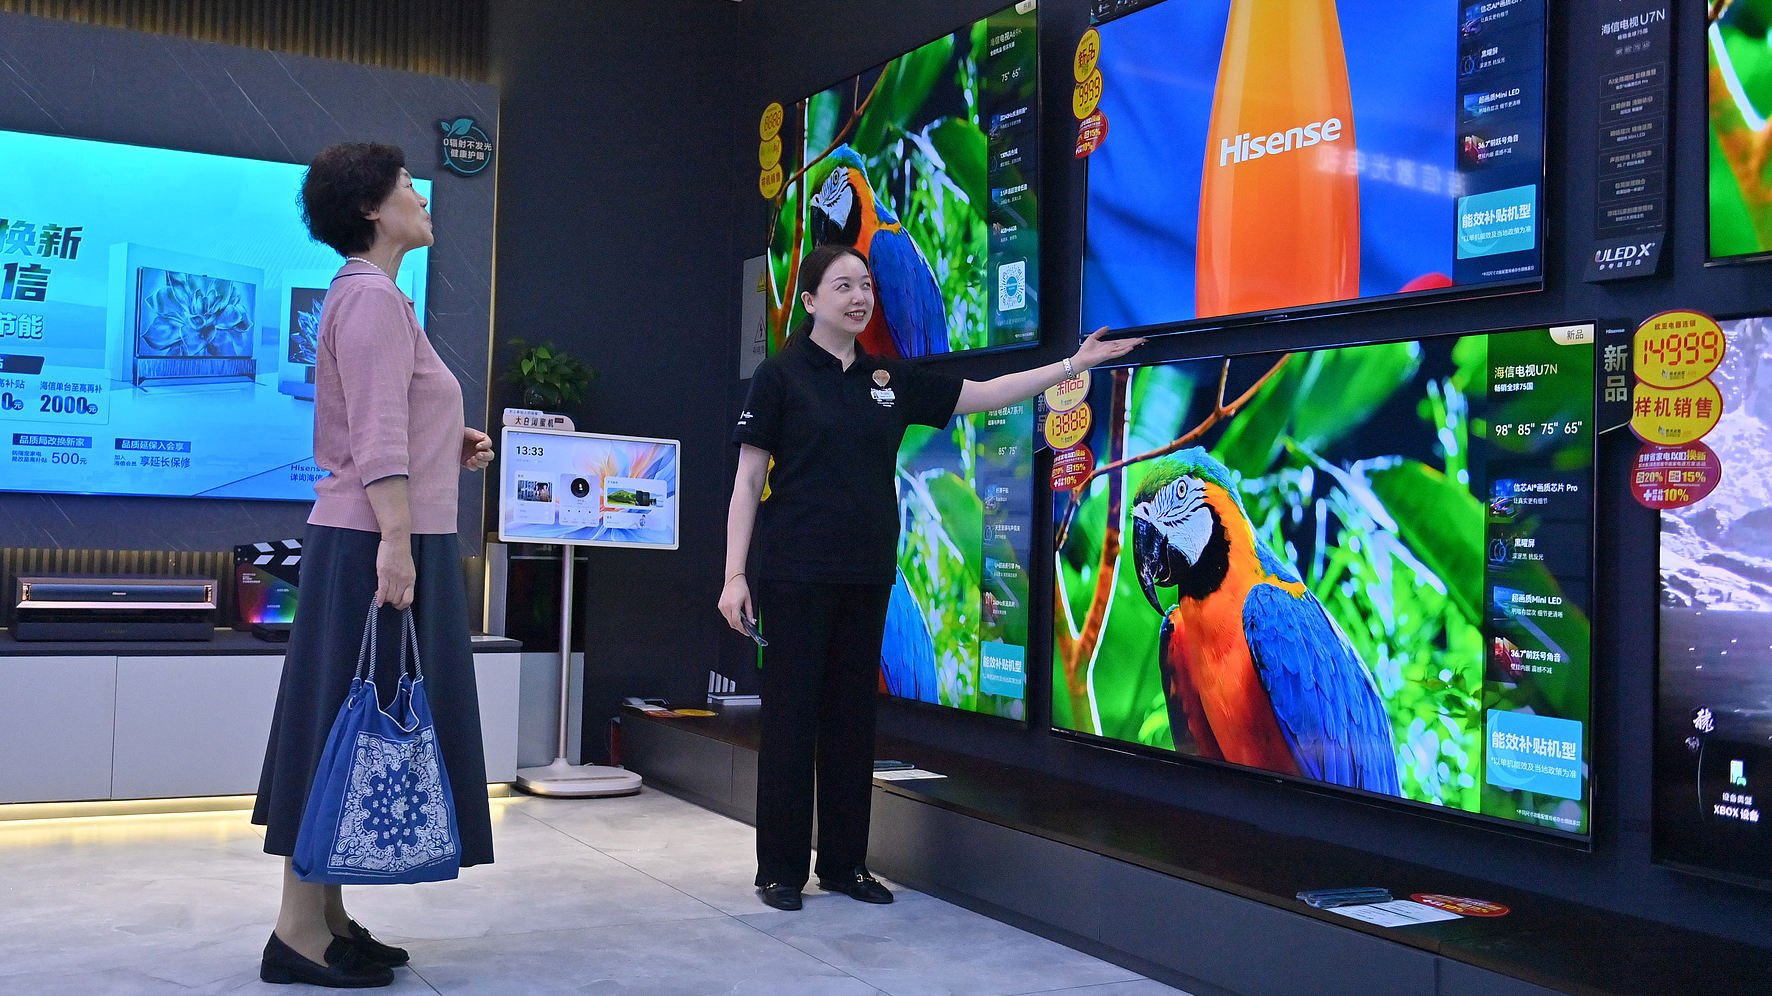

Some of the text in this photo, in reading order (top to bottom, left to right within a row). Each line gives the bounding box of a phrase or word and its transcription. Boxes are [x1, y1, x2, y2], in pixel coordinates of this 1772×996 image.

[1601, 8, 1665, 35] 海信电视U7N
[1508, 87, 1520, 97] LED
[443, 138, 492, 151] 0辐射不发光
[1219, 117, 1342, 167] Hisense
[450, 149, 485, 161] 健康护眼
[1462, 203, 1531, 229] 能效补贴机型
[1595, 246, 1637, 262] ULED
[1567, 329, 1584, 341] 新品
[1644, 331, 1719, 366] 14999
[1494, 364, 1559, 379] 海信电视U7N
[1604, 344, 1628, 403] 新品
[40, 380, 102, 394] 海信单台至高再补
[1494, 382, 1534, 392] 畅销全球75国
[40, 394, 98, 414] 2000元
[1634, 396, 1713, 419] 样机销售
[1495, 420, 1583, 436] 98" 85" 75" 65"
[20, 435, 85, 447] 品质局改换新家
[121, 439, 184, 451] 品质延保入会享
[516, 445, 544, 457] 13:33
[51, 452, 88, 465] 500元
[140, 455, 191, 468] 享延长保修
[1644, 471, 1707, 483] 20% 15%
[1566, 483, 1579, 493] Pro
[1664, 488, 1690, 502] 10%
[1547, 595, 1562, 605] LED
[1492, 731, 1577, 761] 能效补贴机型
[1713, 804, 1760, 823] XBOX 设备
